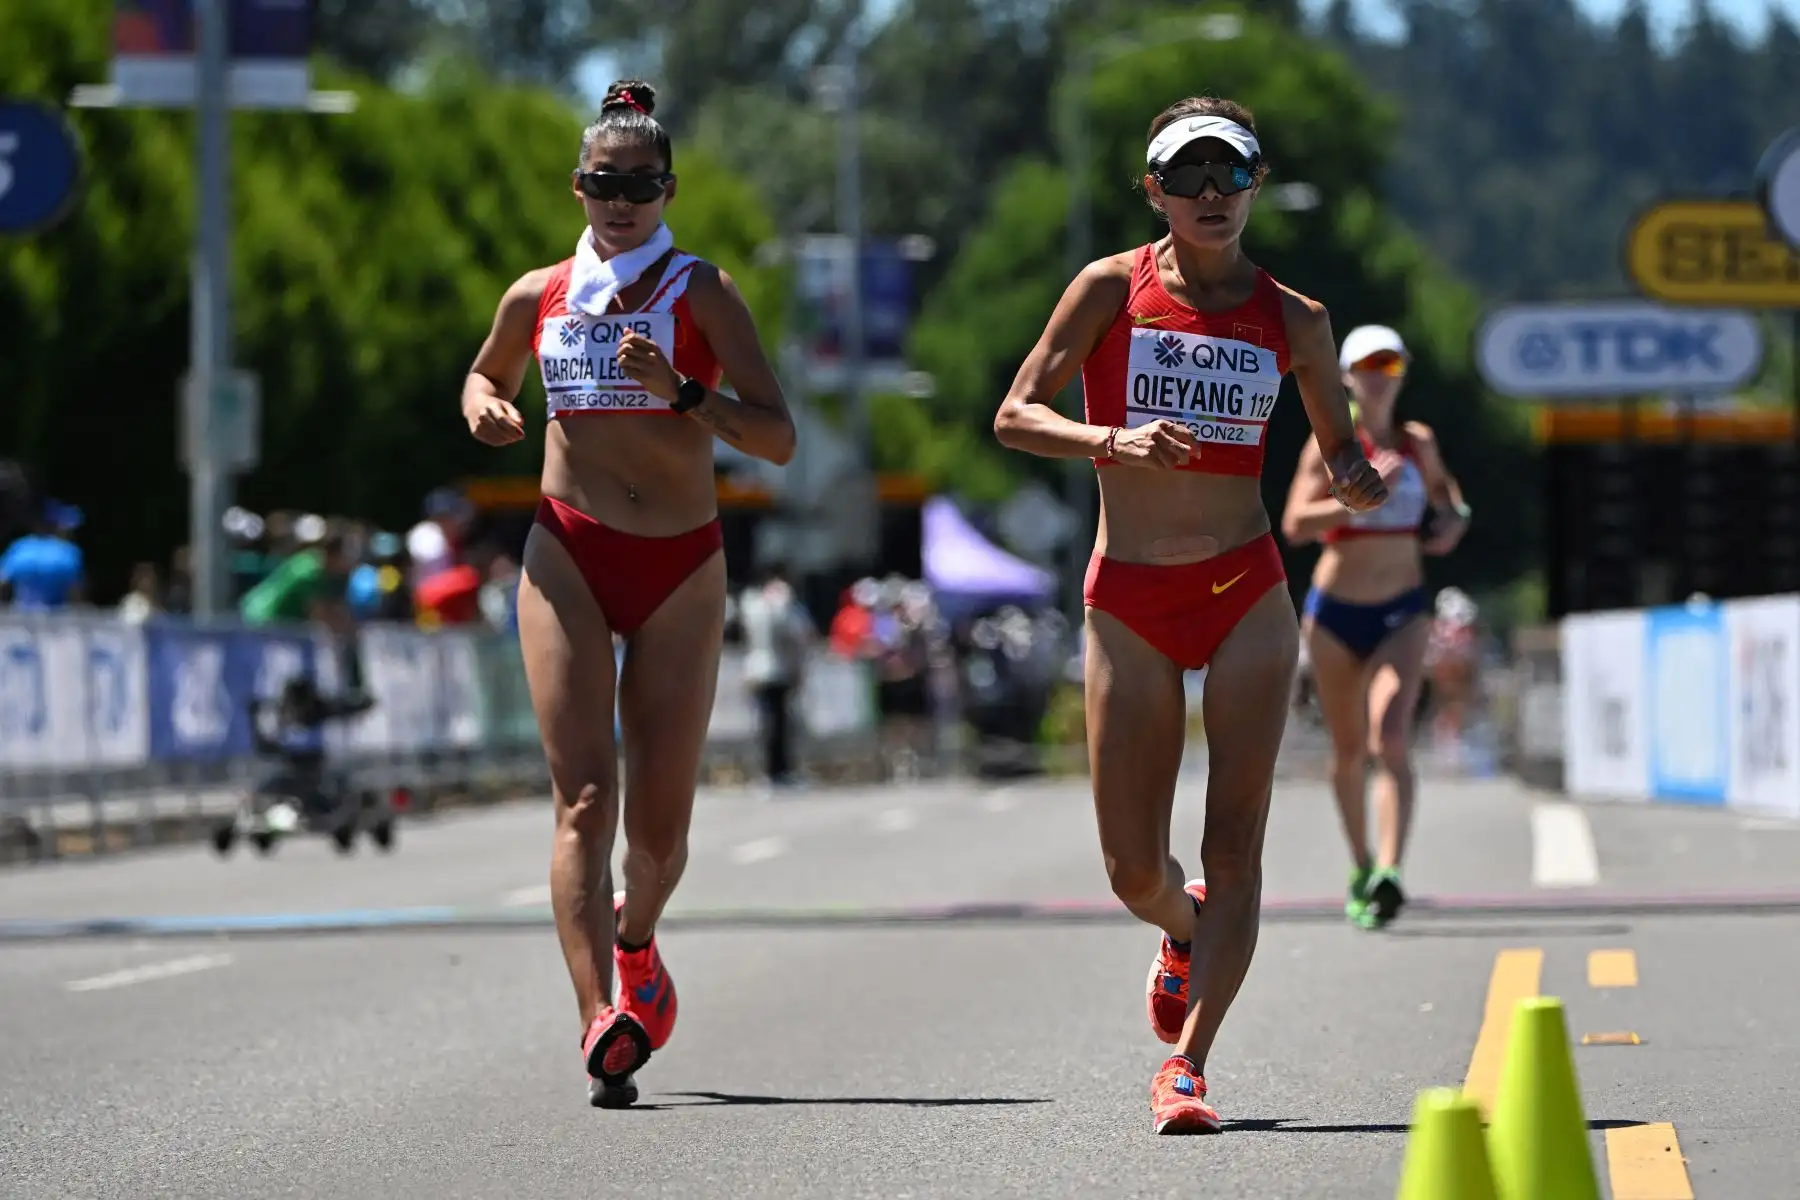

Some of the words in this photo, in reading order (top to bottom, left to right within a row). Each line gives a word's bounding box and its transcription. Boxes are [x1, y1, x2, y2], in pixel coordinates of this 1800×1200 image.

[544, 352, 594, 382] GARCÍA
[1191, 343, 1260, 374] QNB
[562, 393, 649, 408] OREGON22
[1133, 373, 1244, 416] QIEYANG
[1250, 392, 1273, 418] 112
